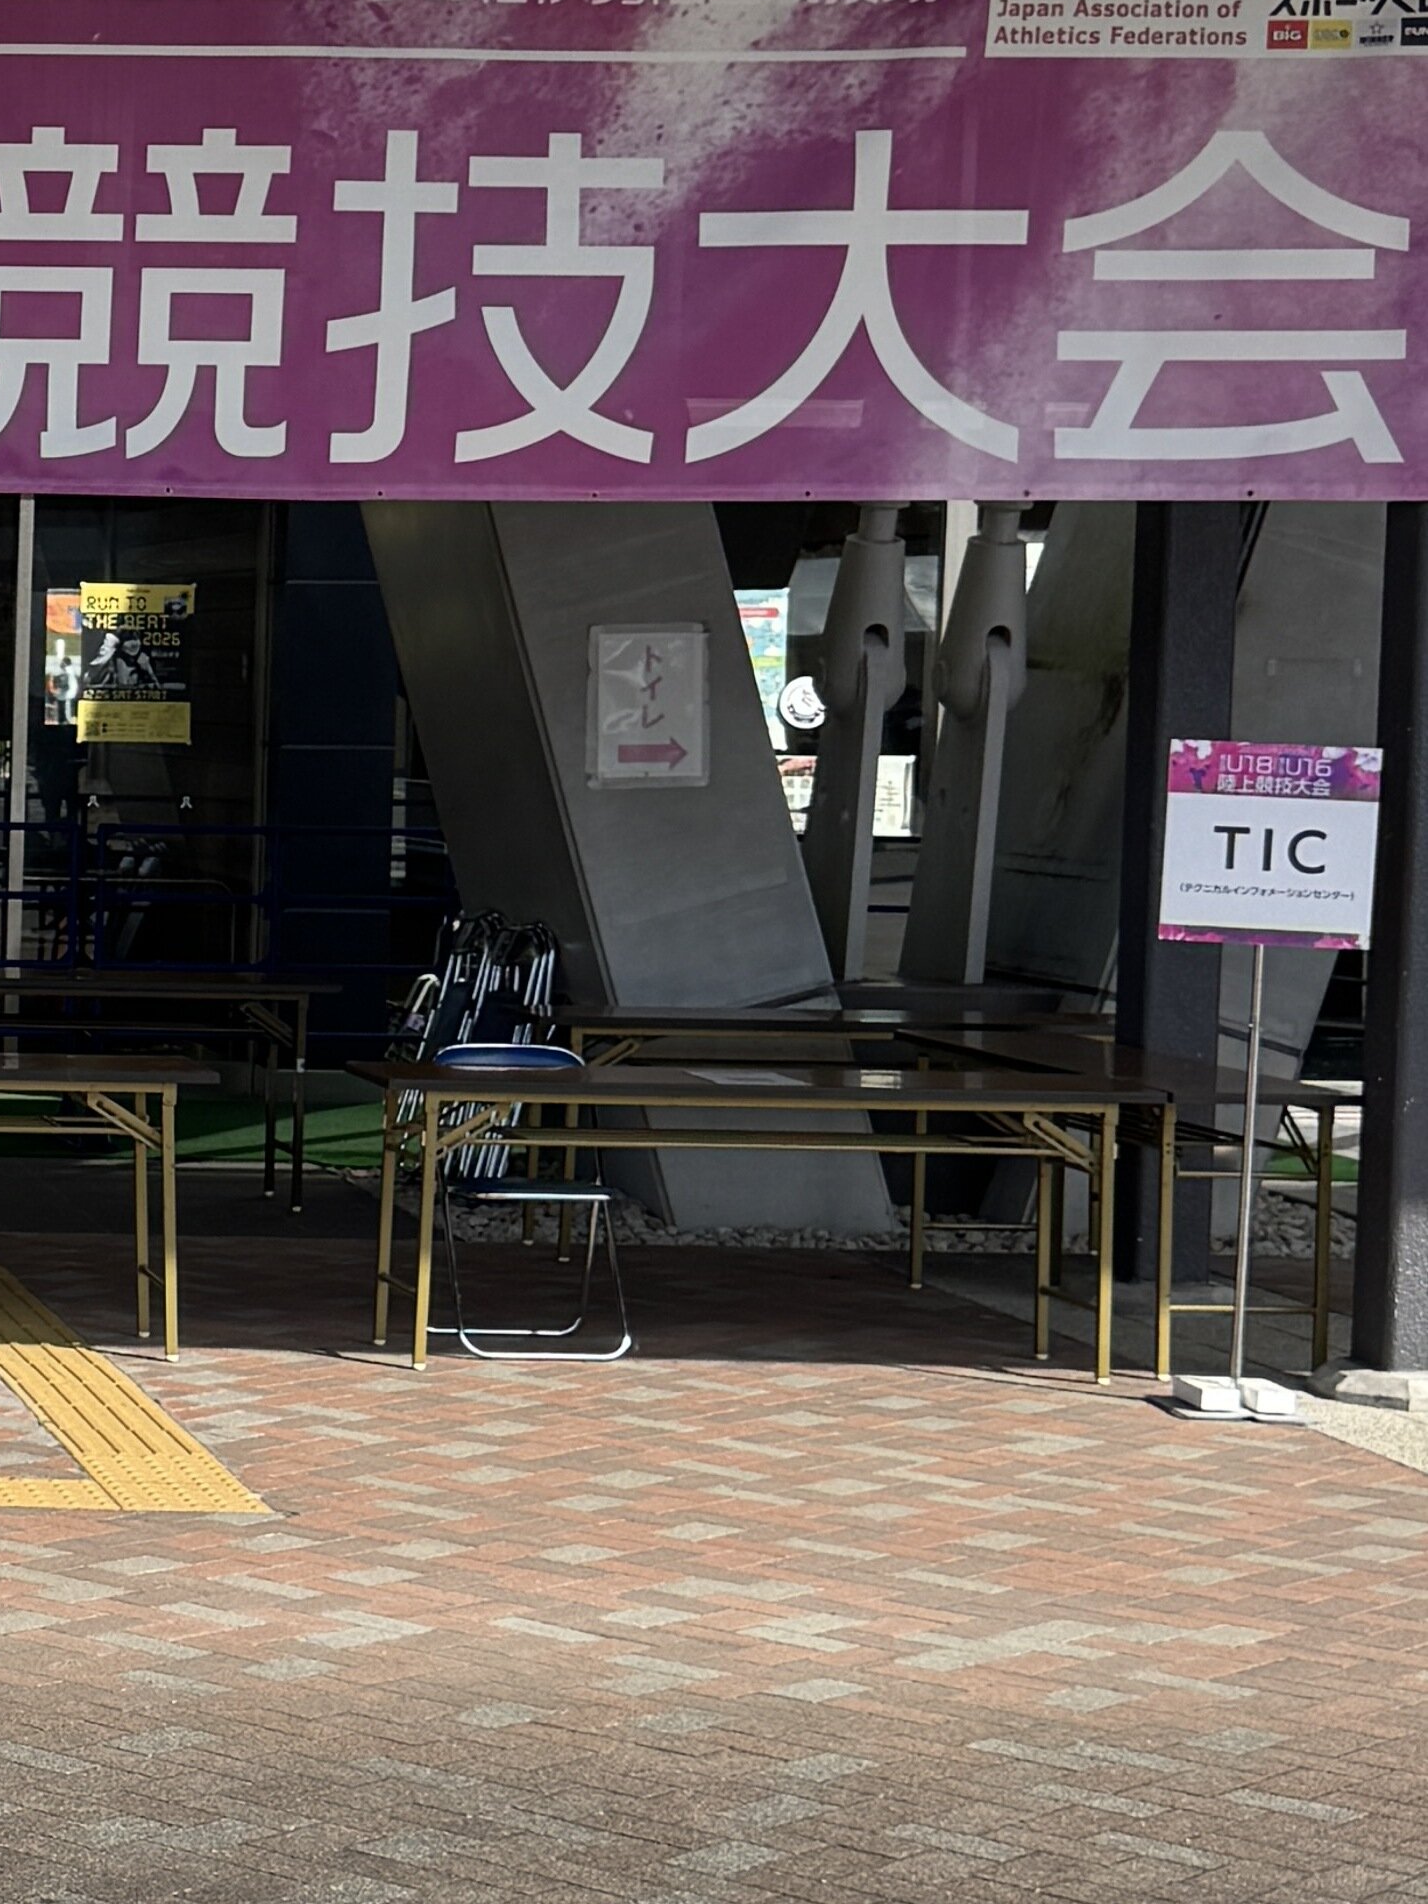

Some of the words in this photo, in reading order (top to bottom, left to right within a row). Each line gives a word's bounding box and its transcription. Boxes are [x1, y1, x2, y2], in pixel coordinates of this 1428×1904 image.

[1217, 0, 1242, 19] of
[994, 26, 1101, 46] Athletics
[1110, 26, 1248, 46] Federations
[87, 596, 119, 610] RUN
[126, 596, 147, 611] TO
[85, 614, 117, 629] THE
[143, 631, 181, 647] 2026
[640, 644, 665, 730] トイレ
[1217, 776, 1331, 796] 陸上競技大会
[1213, 825, 1327, 874] TIC
